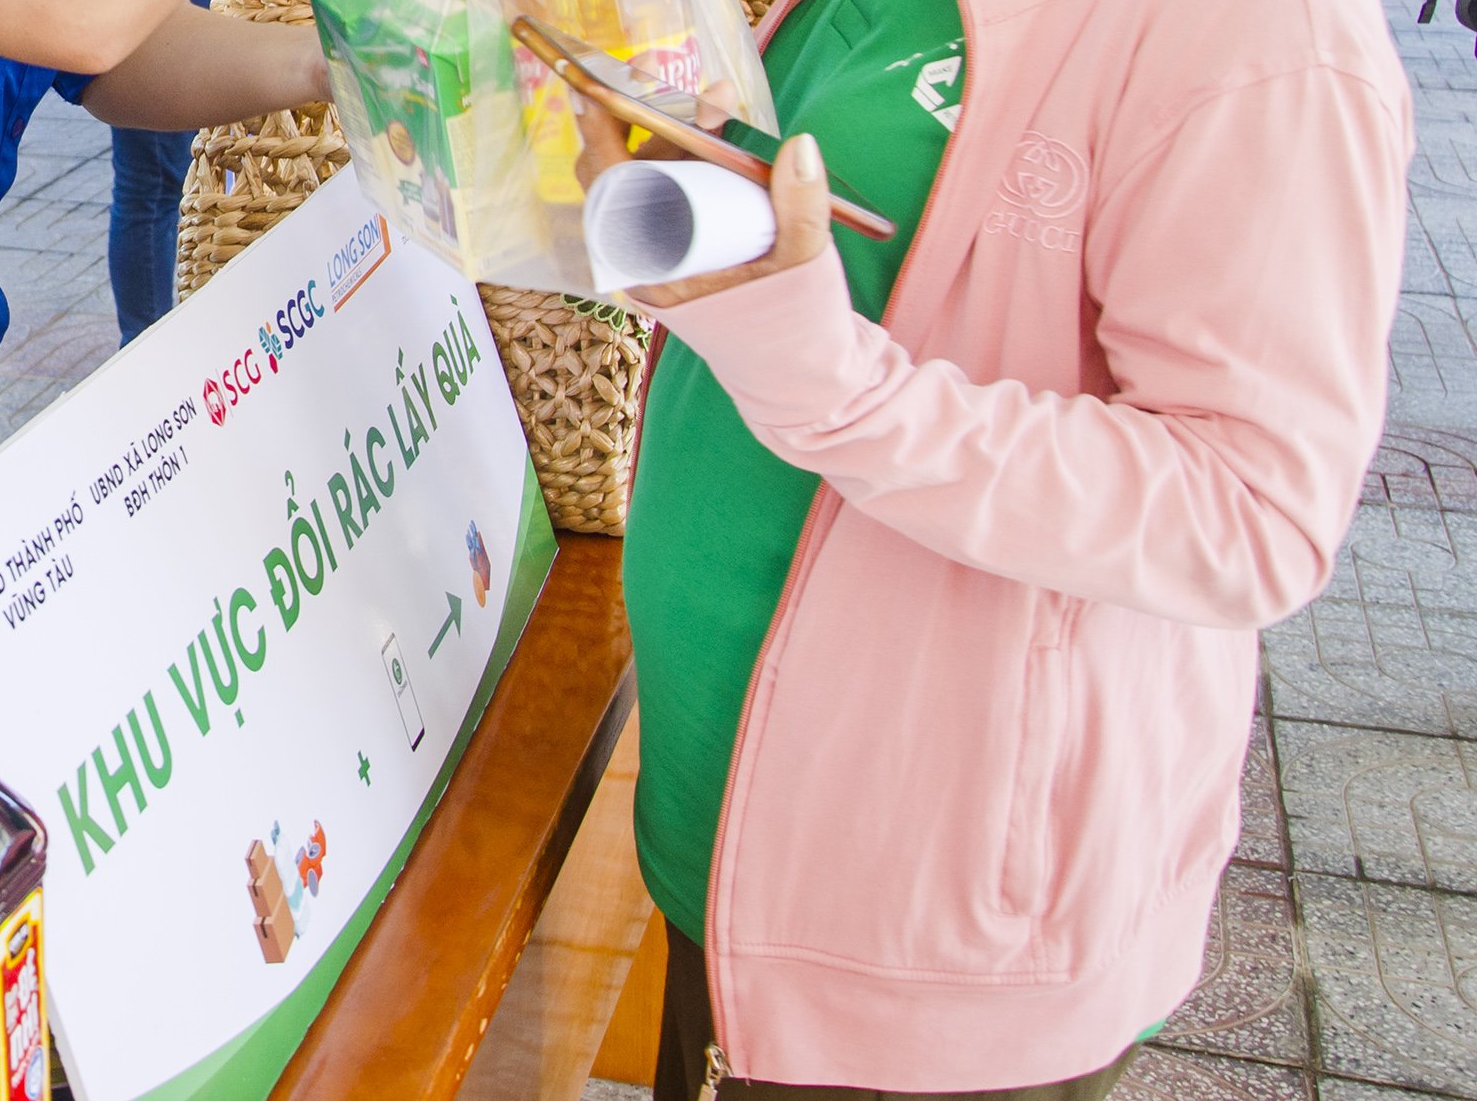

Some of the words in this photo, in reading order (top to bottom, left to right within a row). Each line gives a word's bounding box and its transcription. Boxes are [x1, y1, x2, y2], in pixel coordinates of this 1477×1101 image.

[327, 237, 358, 288] LONG
[276, 279, 325, 350] SCGC
[223, 348, 262, 406] SCG
[89, 463, 125, 506] UBND
[123, 442, 144, 477] XÃ
[141, 419, 174, 459] LONG
[172, 396, 198, 431] SƠN
[123, 480, 151, 518] BĐH
[148, 451, 182, 494] THÔN
[180, 445, 189, 465] 1
[5, 527, 56, 582] THÀNH
[54, 490, 84, 541] PHỐ
[2, 581, 46, 630] VŨNG
[46, 554, 74, 593] TÀU
[56, 690, 173, 876] KHU
[166, 587, 267, 737] VỰC
[263, 470, 338, 633] ĐỔI
[327, 427, 395, 550] RÁC
[387, 346, 440, 470] LẤY
[431, 295, 481, 404] QUÀ
